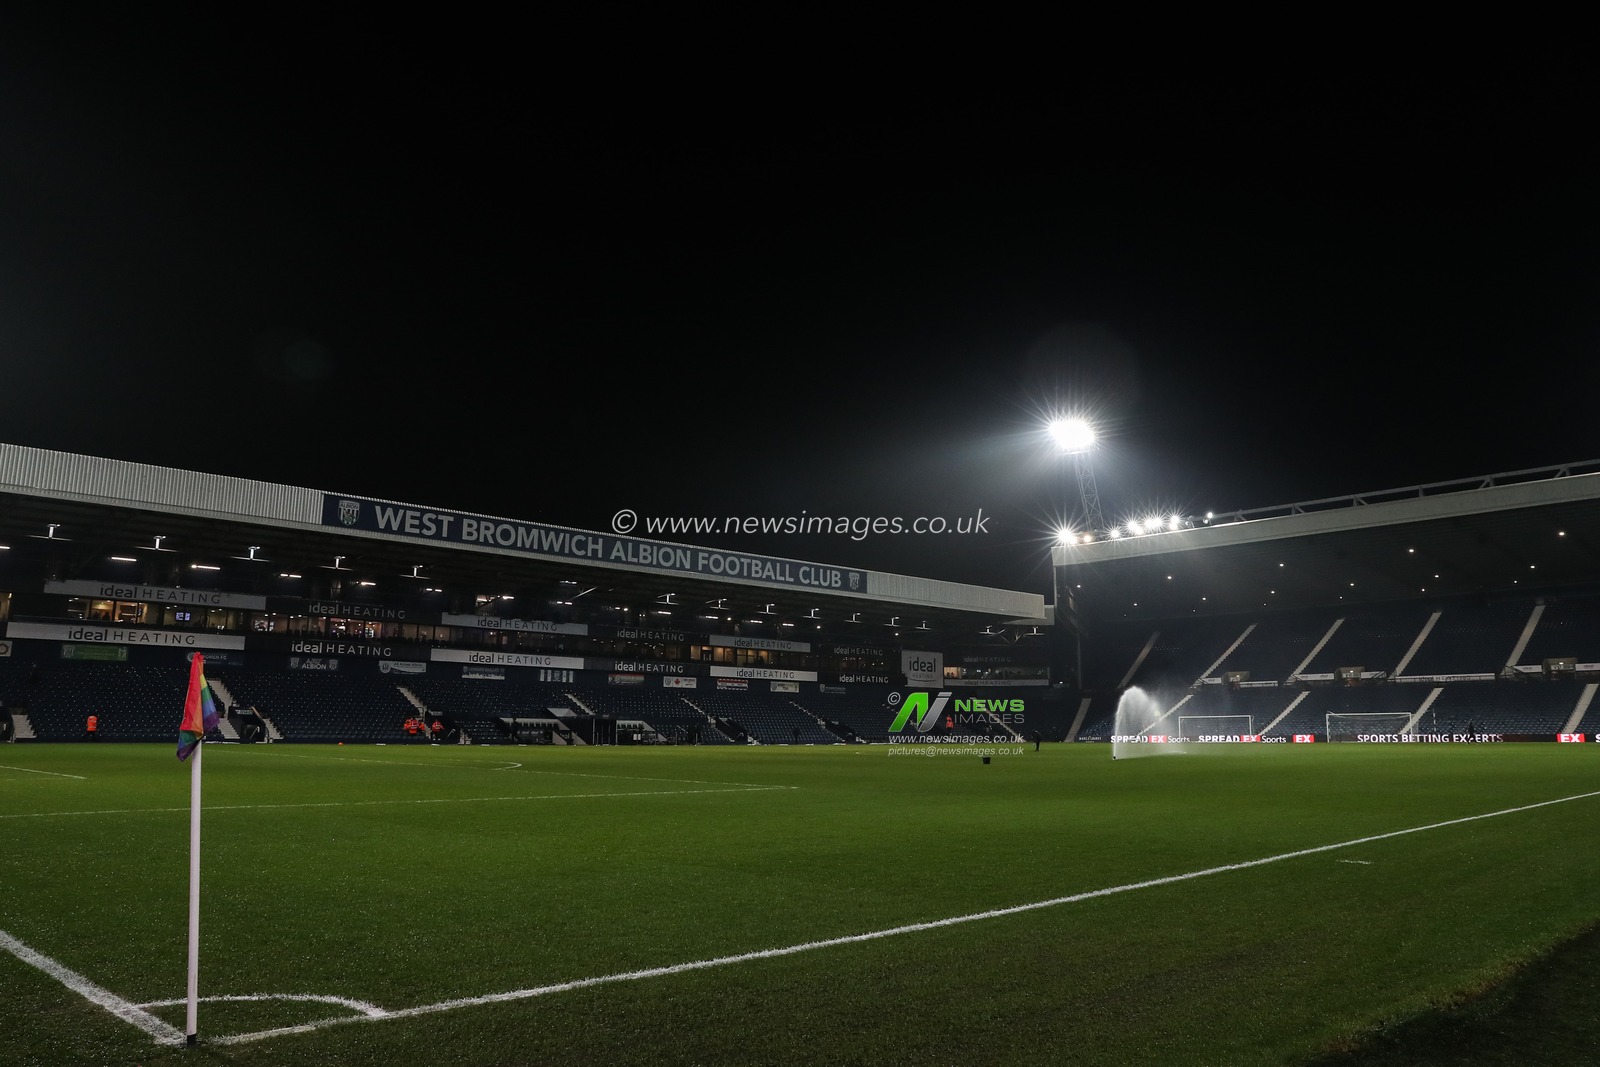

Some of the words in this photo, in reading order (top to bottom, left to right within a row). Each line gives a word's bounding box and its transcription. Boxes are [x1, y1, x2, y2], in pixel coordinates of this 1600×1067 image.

[374, 505, 455, 538] WEST
[462, 518, 603, 559] BROMWICH
[609, 541, 692, 570] ALBION
[698, 551, 795, 584] FOOTBALL
[799, 566, 842, 589] CLUB
[100, 584, 138, 599] ideal
[142, 589, 220, 604] HEATING
[309, 603, 339, 615] ideal
[342, 606, 406, 619] HEATING
[477, 618, 502, 629] ideal
[505, 620, 558, 632] HEATING
[68, 627, 108, 641] ideal
[113, 631, 195, 645] HEATING
[617, 629, 638, 639] ideal
[640, 631, 685, 642] HEATING
[291, 641, 322, 654] ideal
[326, 644, 392, 657] HEATING
[734, 639, 752, 648] ideal
[754, 641, 792, 650] HEATING
[834, 646, 850, 655] ideal
[851, 648, 883, 656] HEATING
[469, 653, 494, 664] ideal
[497, 656, 551, 666] HEATING
[909, 657, 936, 673] ideal
[614, 661, 636, 672] ideal
[638, 663, 684, 674] HEATING
[736, 669, 755, 678] ideal
[757, 671, 795, 679] HEATING
[839, 674, 855, 683] ideal
[857, 676, 889, 684] HEATING
[1261, 735, 1286, 743] Sports
[1295, 734, 1311, 743] EX
[1357, 734, 1399, 743] SPORTS
[1401, 733, 1450, 743] BETTING
[1560, 733, 1581, 743] EX
